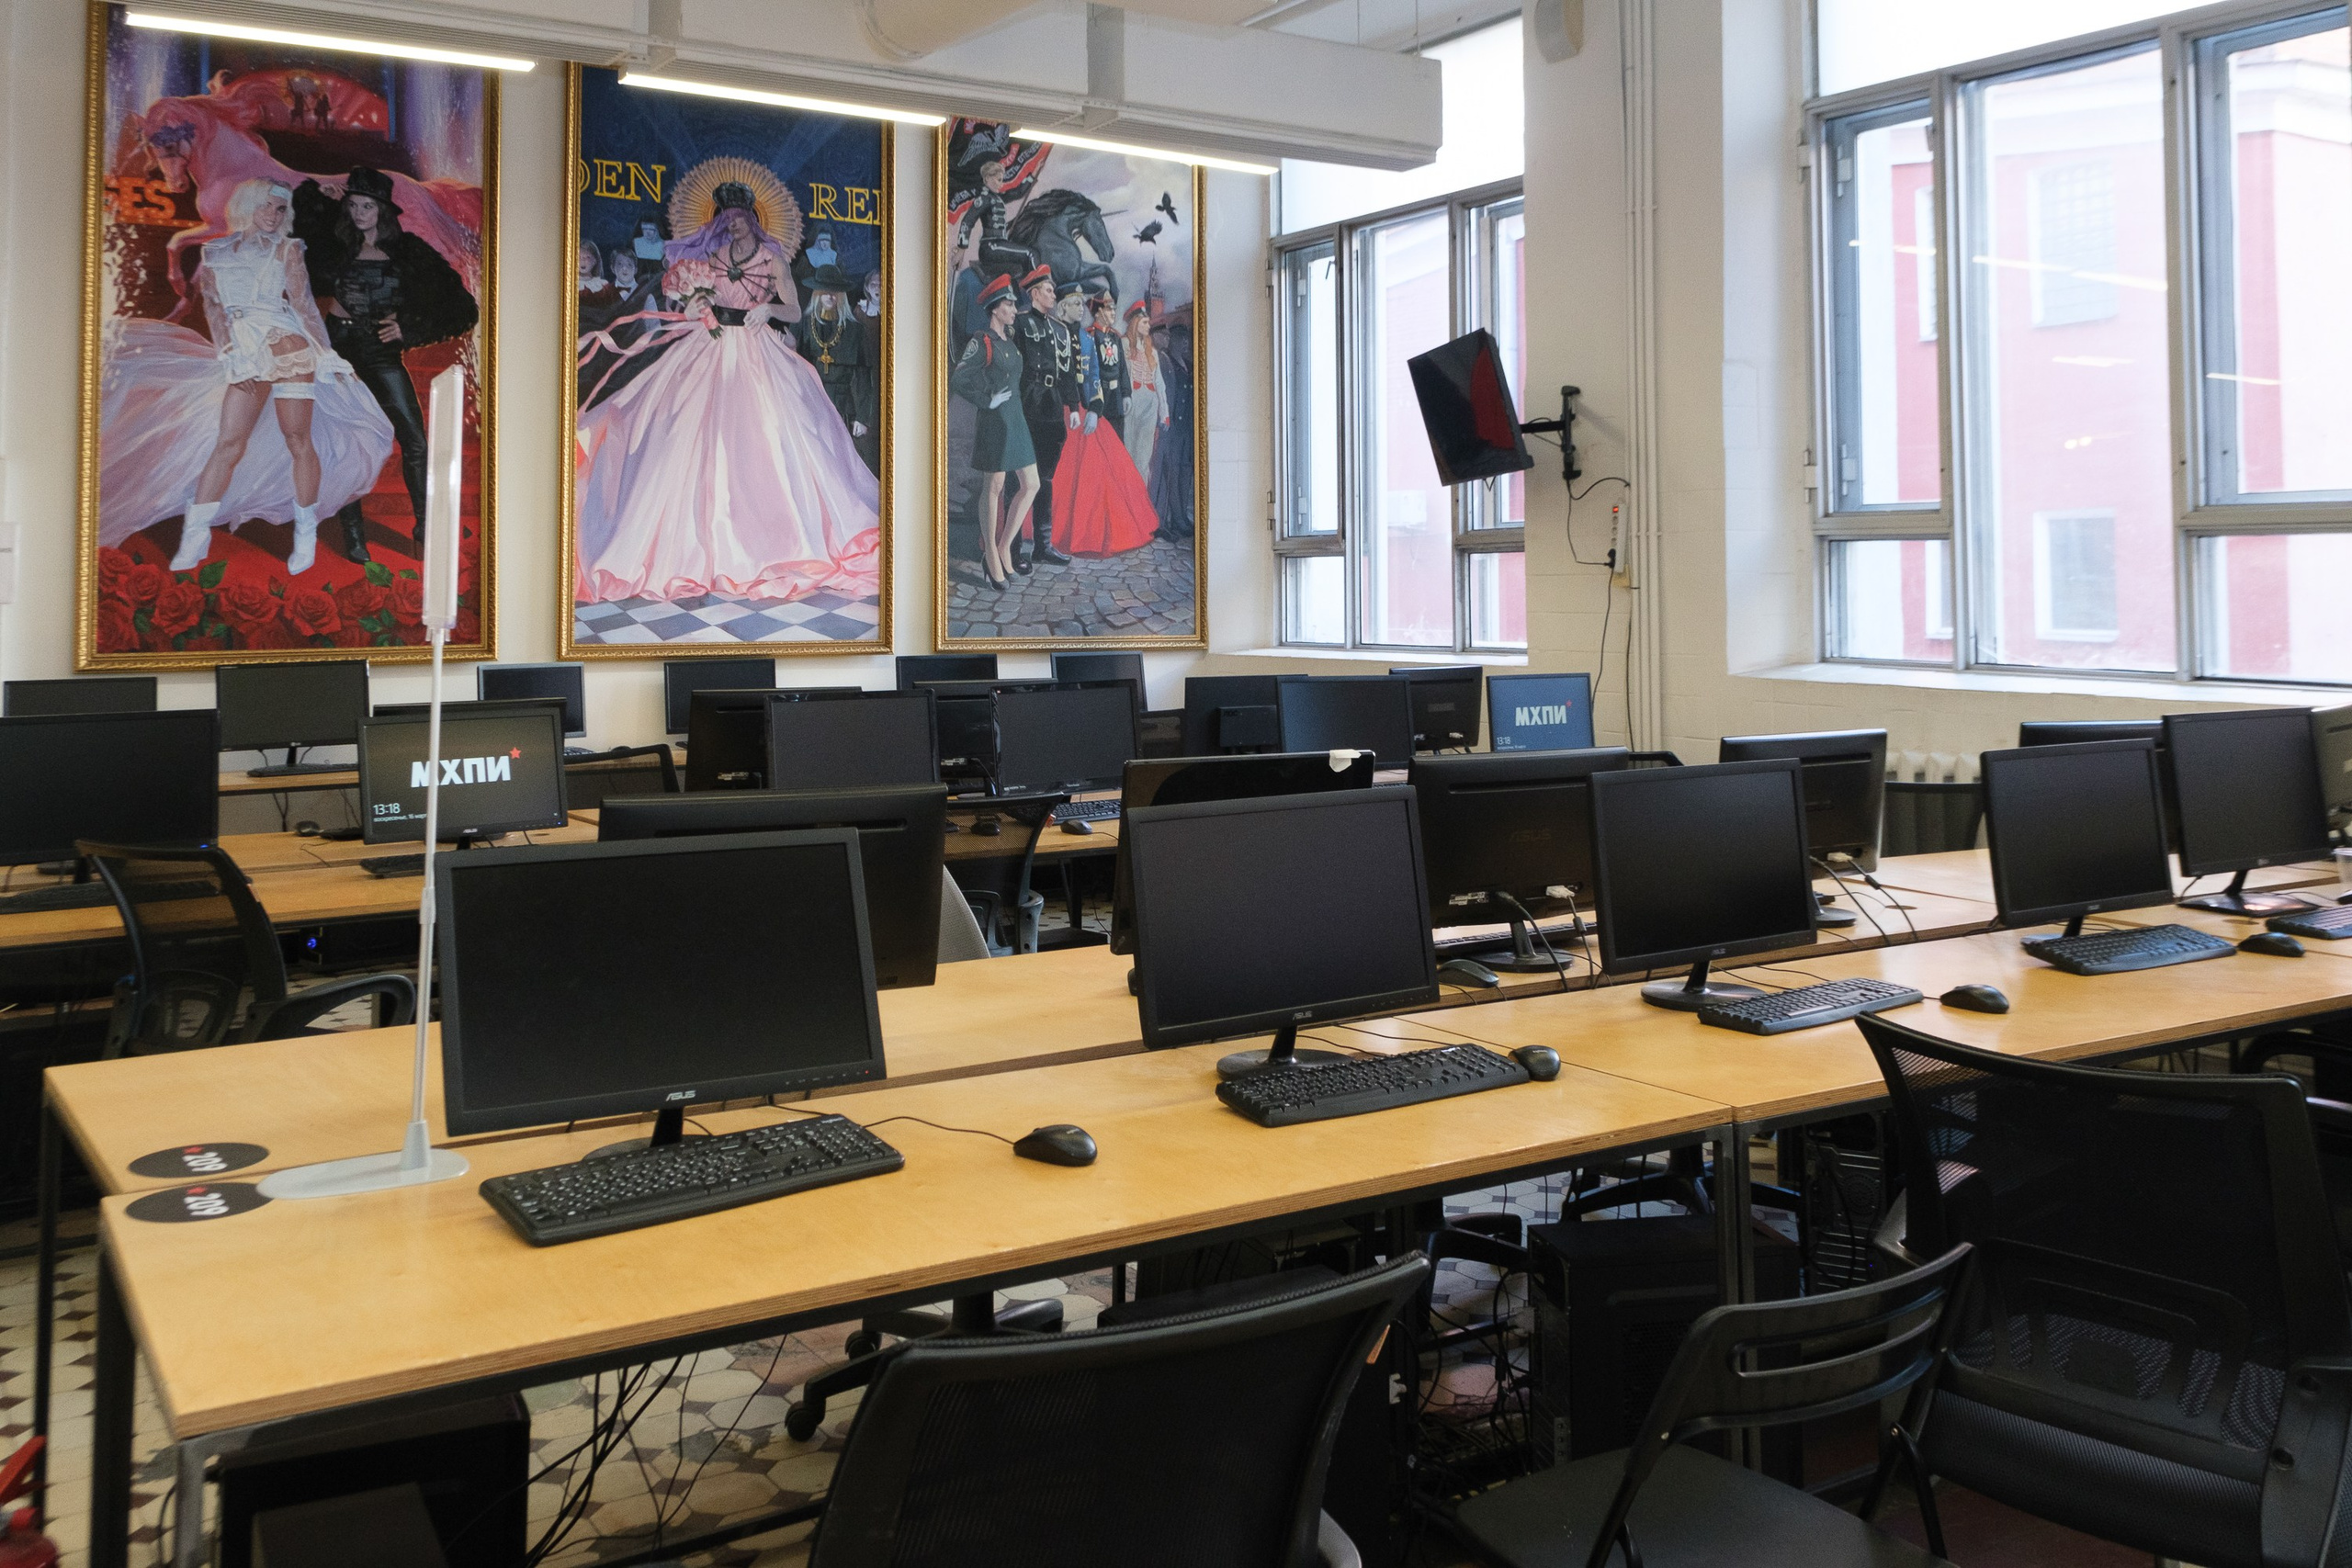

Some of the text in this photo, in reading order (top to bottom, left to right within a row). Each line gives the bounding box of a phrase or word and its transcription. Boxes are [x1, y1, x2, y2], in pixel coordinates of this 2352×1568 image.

[1017, 141, 1041, 164] ОТЕЧЕС
[1515, 705, 1567, 727] МХПИ
[372, 802, 401, 815] 13:18
[665, 1089, 696, 1101] ASUS
[182, 1151, 228, 1172] 209
[184, 1192, 230, 1216] 209
